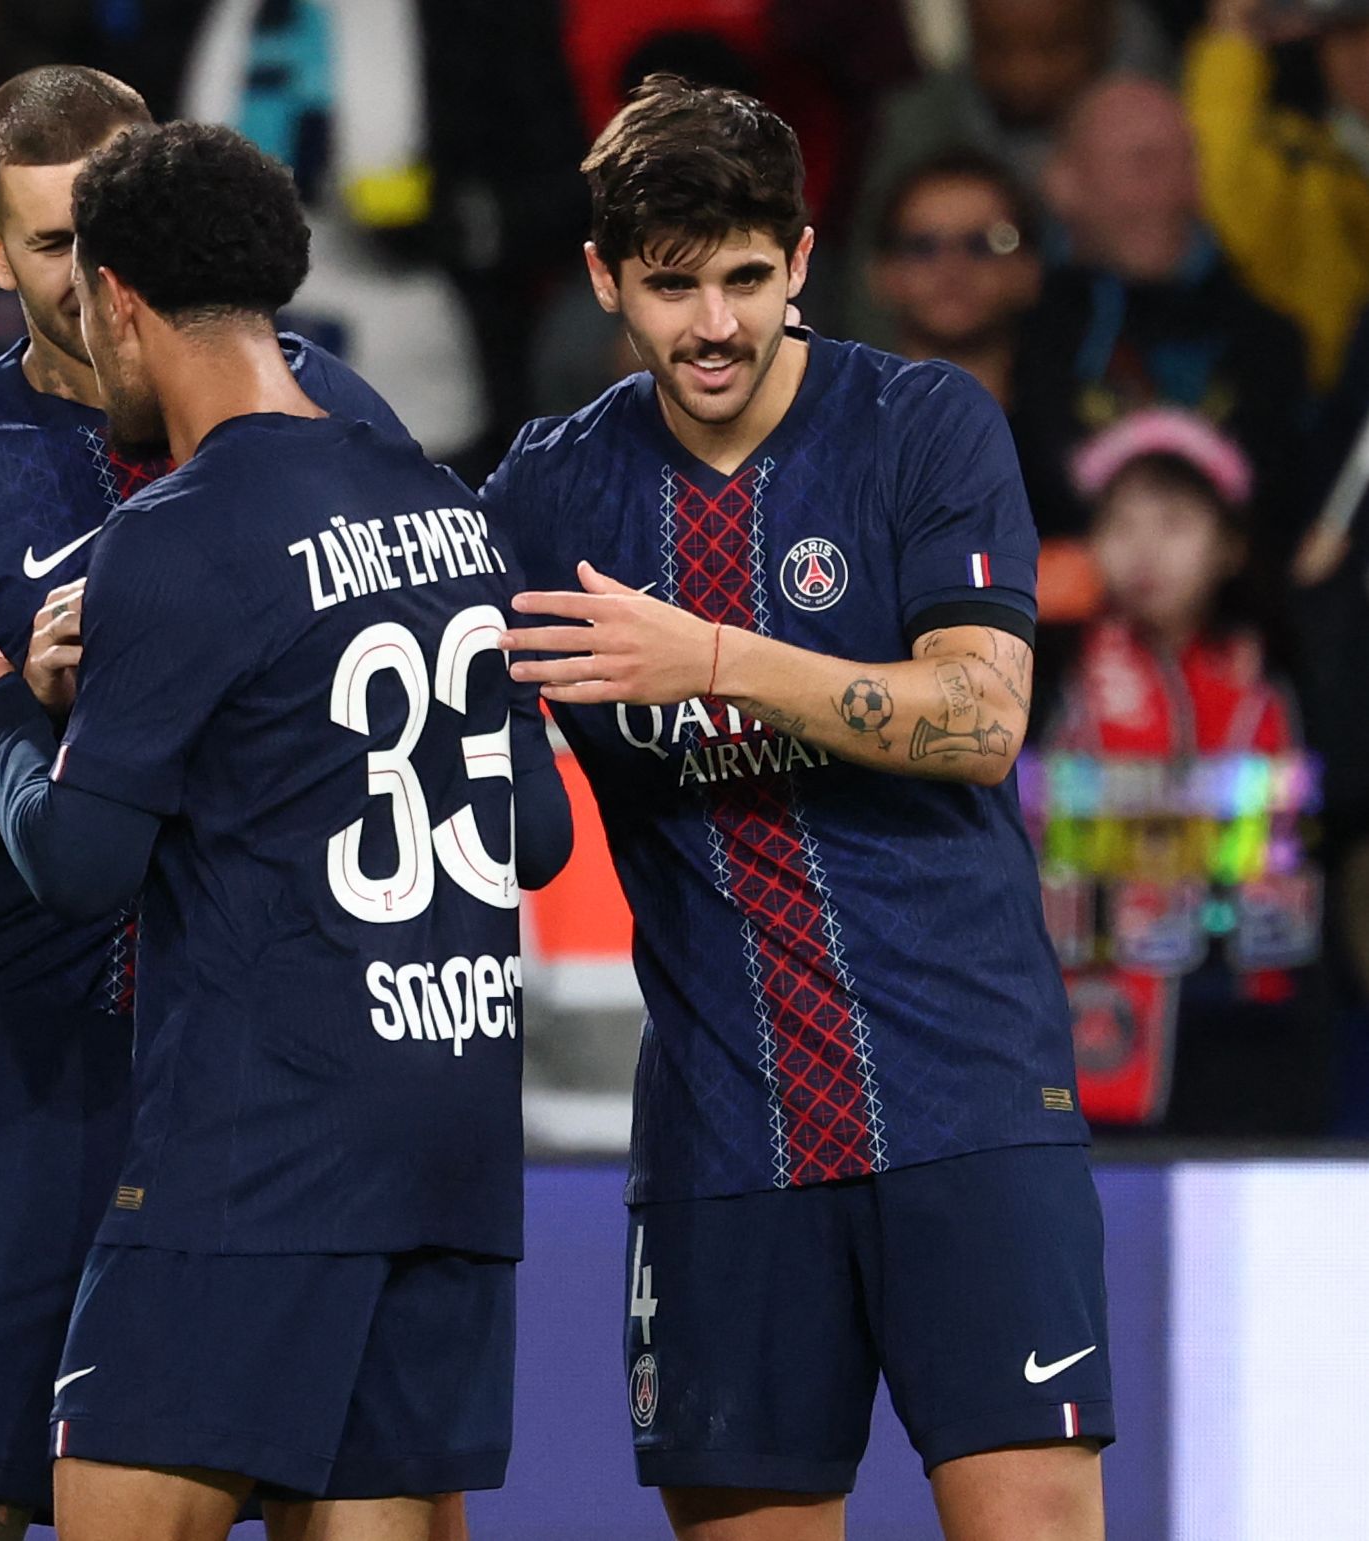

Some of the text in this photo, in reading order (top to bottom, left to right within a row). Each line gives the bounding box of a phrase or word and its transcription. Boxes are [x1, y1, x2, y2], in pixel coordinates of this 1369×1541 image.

[791, 541, 833, 563] PARIS
[328, 604, 520, 923] 33
[366, 954, 523, 1057] snipes
[631, 1225, 659, 1345] 4
